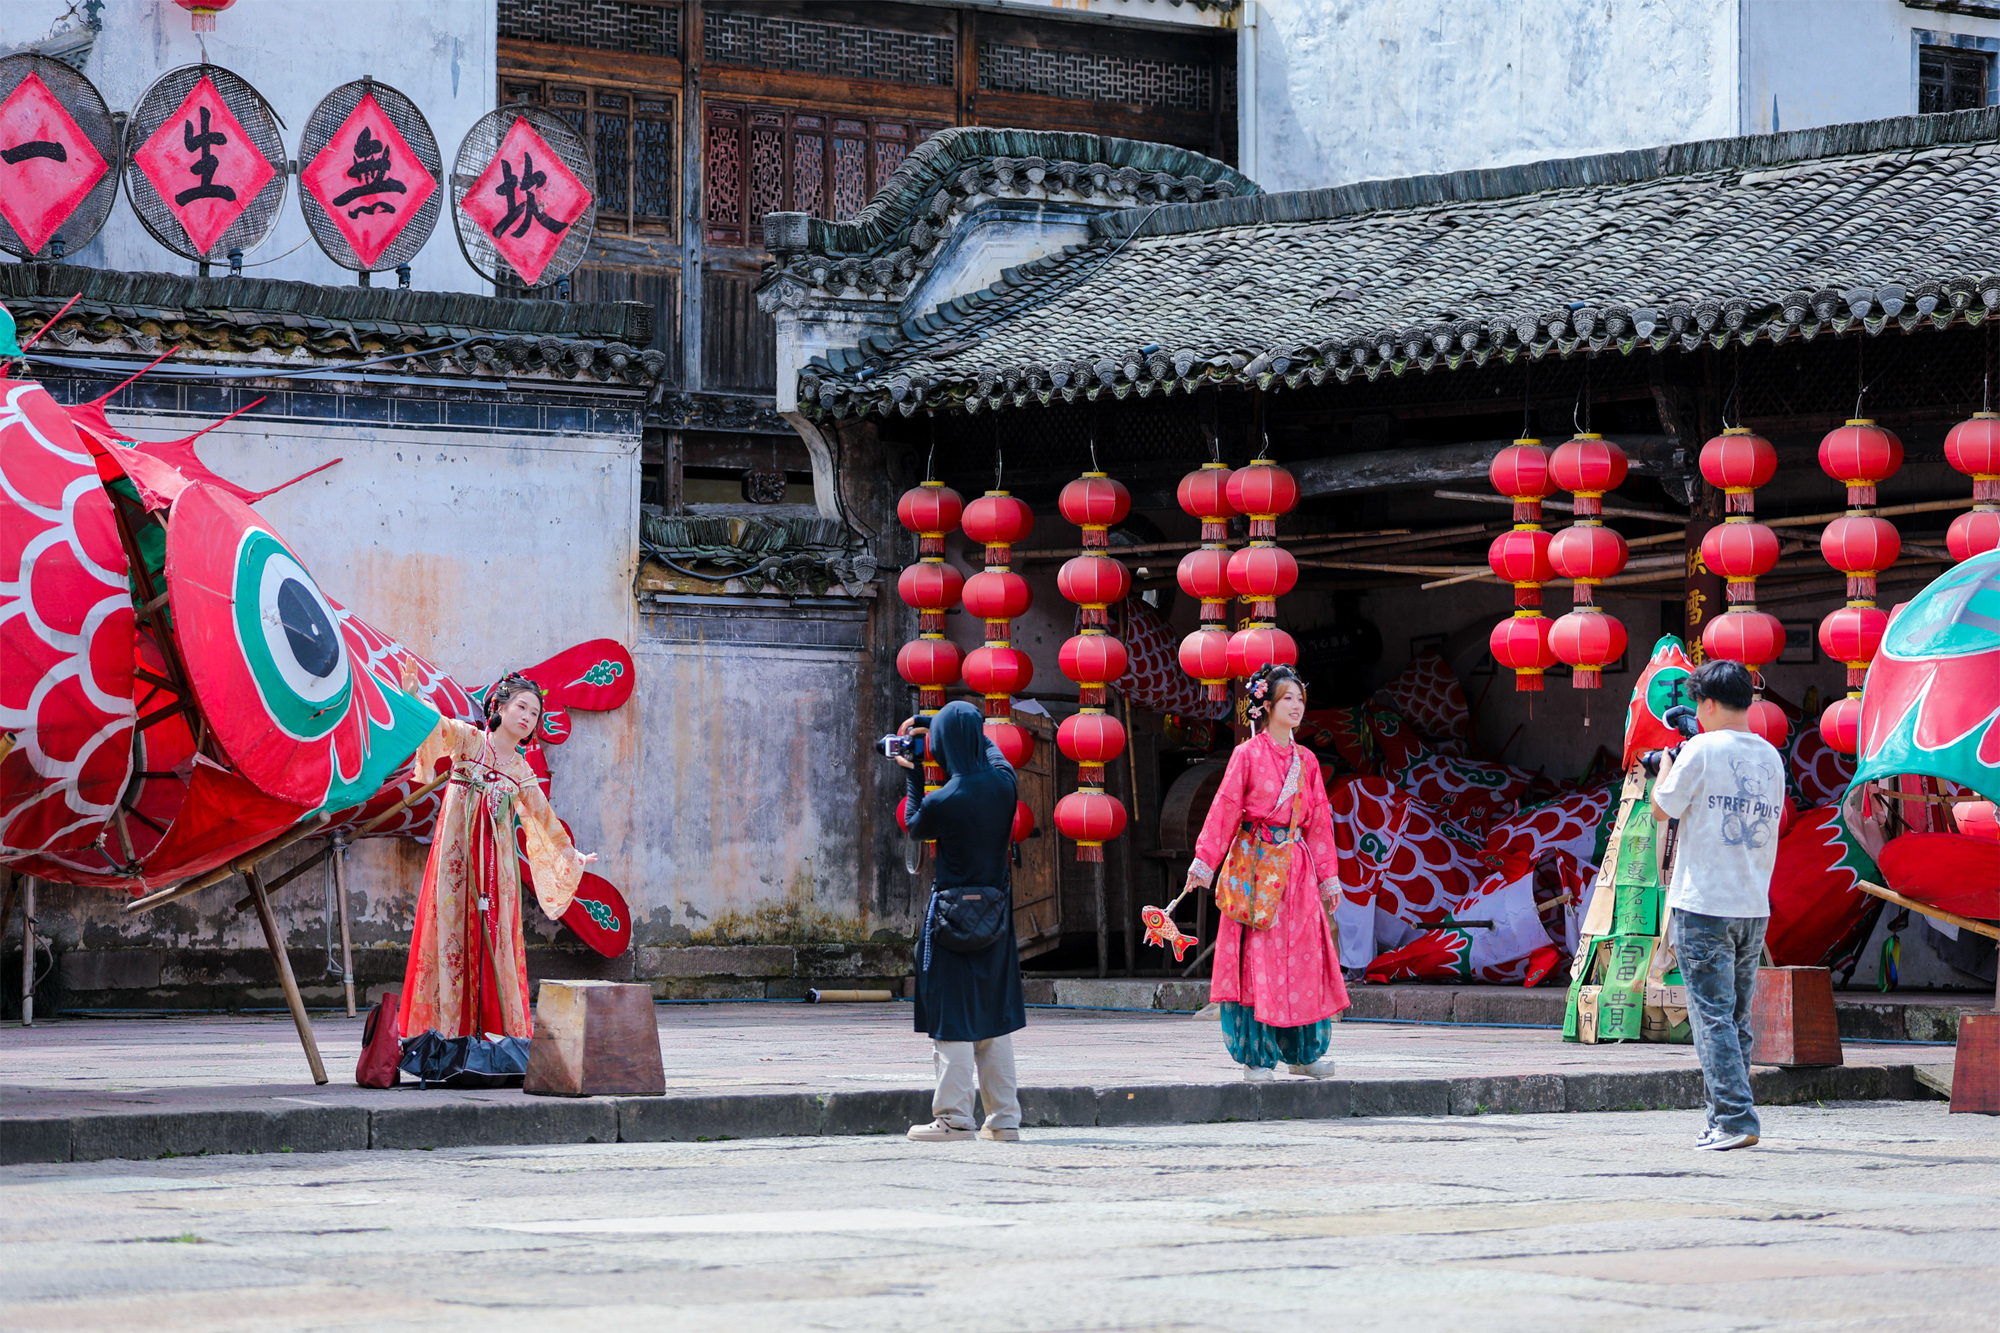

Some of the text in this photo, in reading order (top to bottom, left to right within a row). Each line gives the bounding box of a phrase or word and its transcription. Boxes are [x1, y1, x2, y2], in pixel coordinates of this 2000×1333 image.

[0, 141, 68, 165] 一
[175, 105, 238, 207] 生
[332, 126, 408, 219] 無
[492, 151, 569, 239] 坎
[1708, 795, 1752, 814] STREET
